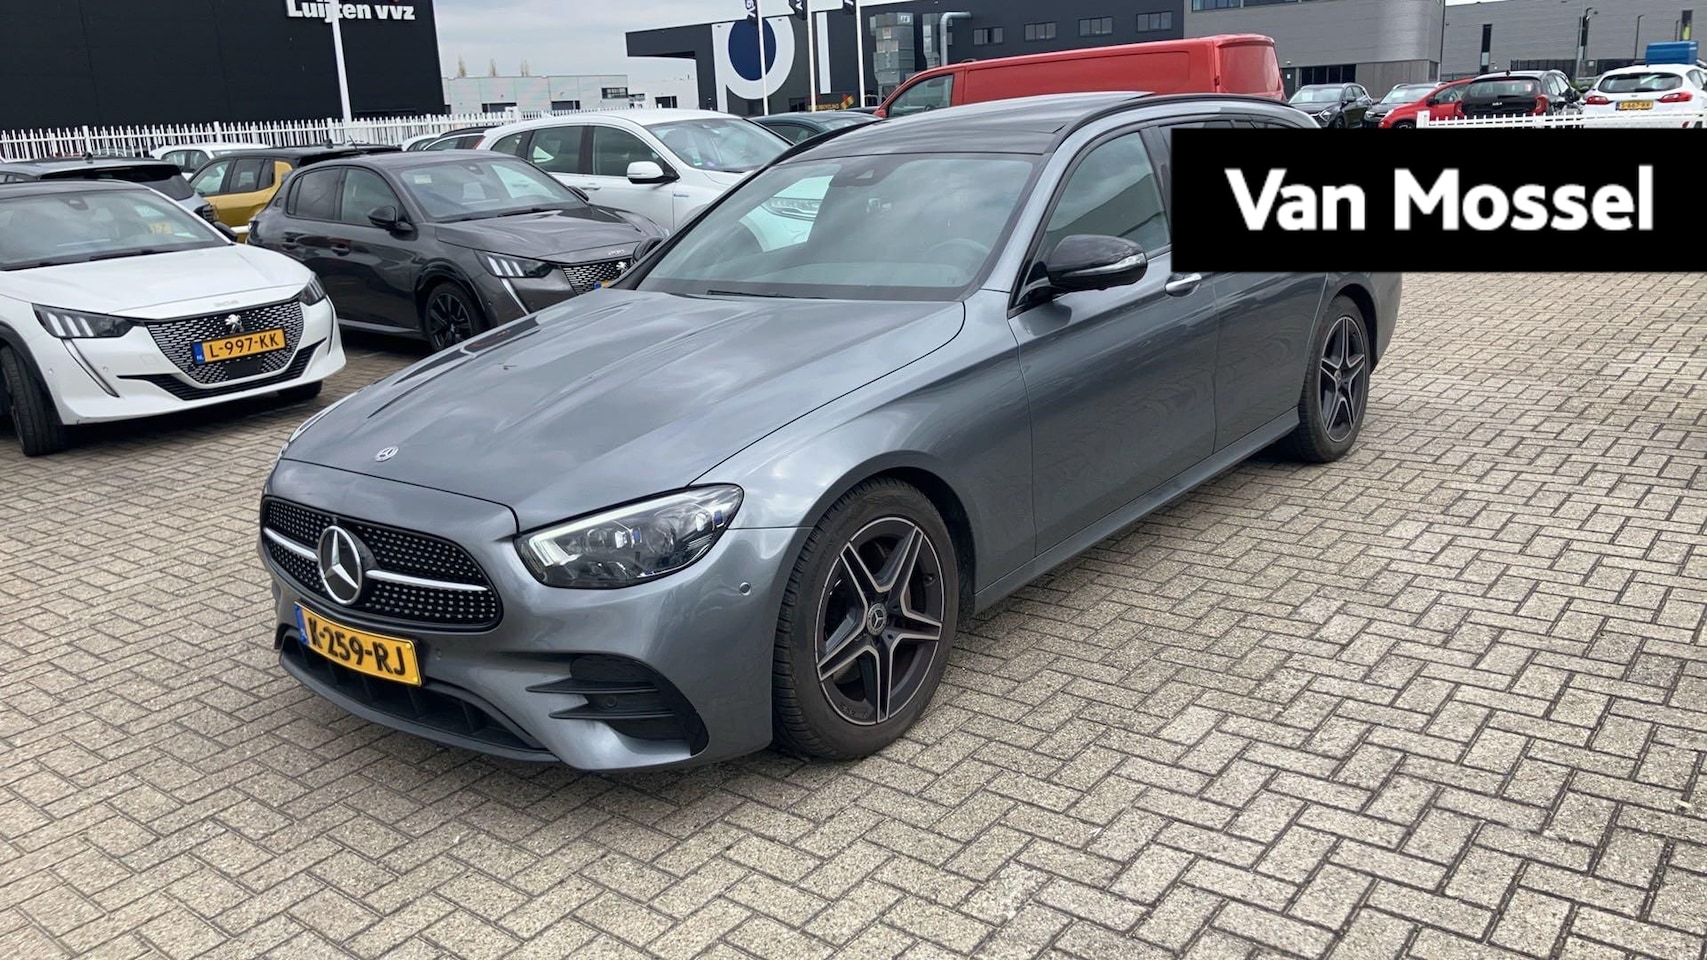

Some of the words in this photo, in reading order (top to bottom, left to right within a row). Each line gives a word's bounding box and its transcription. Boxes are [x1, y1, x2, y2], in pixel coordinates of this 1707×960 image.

[374, 5, 416, 20] vvz
[209, 333, 279, 358] L-997-KK
[307, 617, 406, 676] K-259-RJ
